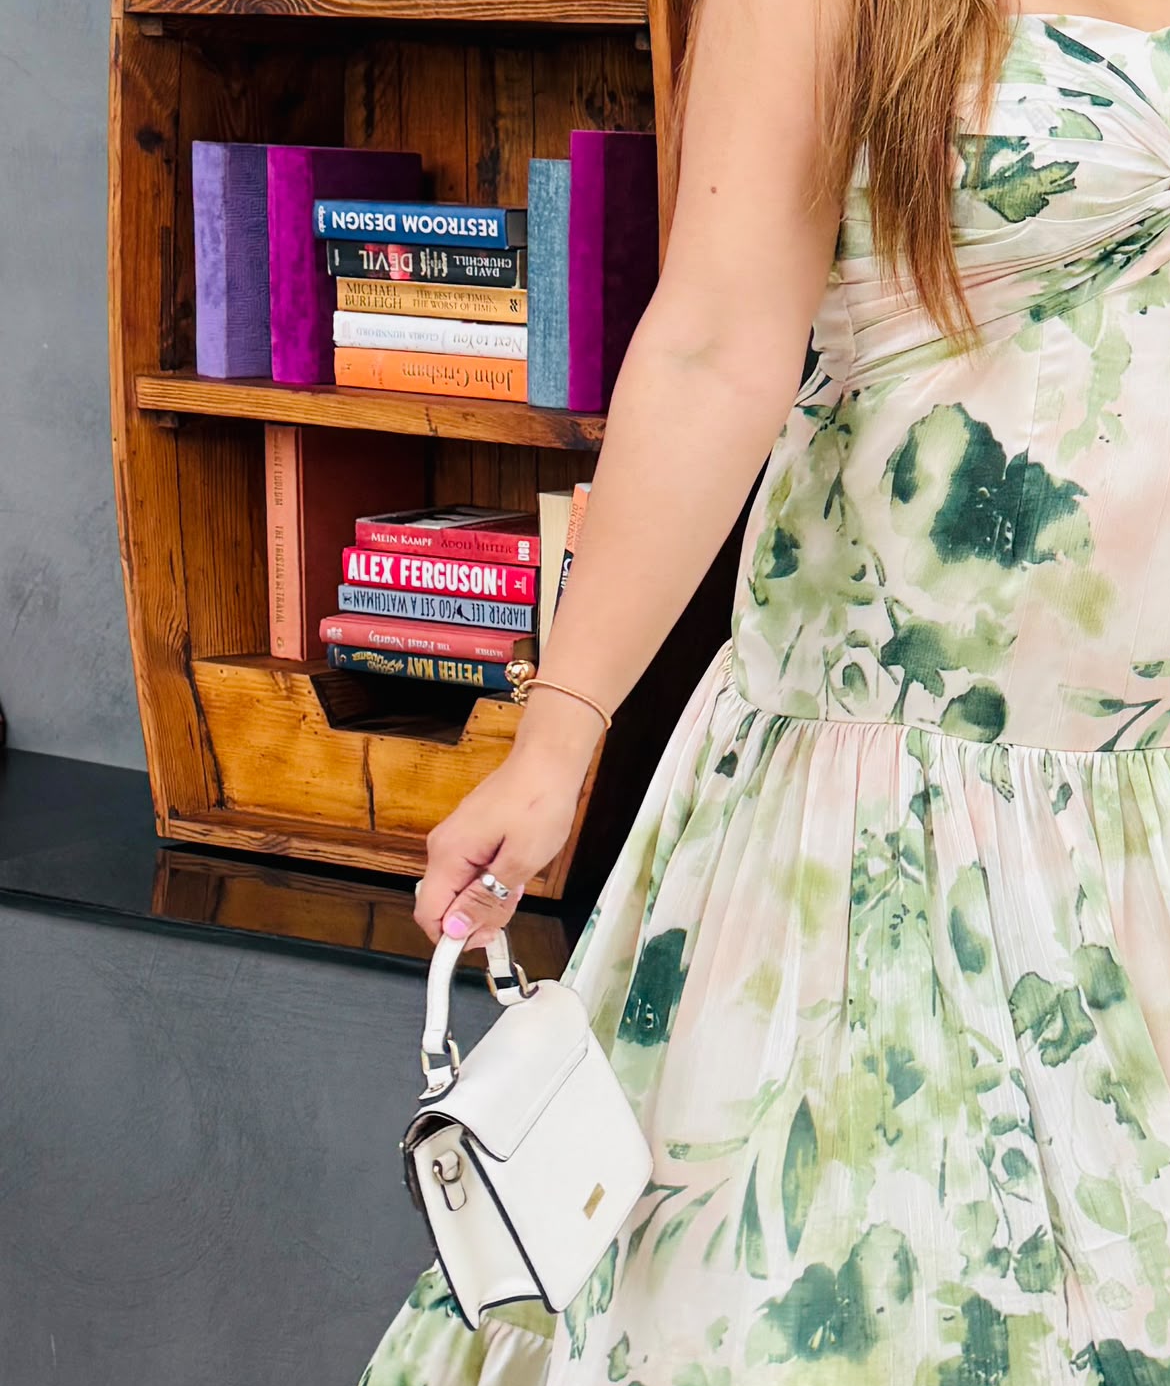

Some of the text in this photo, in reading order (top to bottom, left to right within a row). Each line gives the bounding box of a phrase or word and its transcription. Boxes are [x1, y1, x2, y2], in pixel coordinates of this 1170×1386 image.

[332, 211, 499, 237] RESTROOM DESIGN
[358, 250, 413, 273] DEVIL
[452, 255, 512, 269] CHURCHILL
[466, 267, 500, 277] DAVID
[346, 283, 399, 297] MICHAEL
[416, 289, 434, 299] THE
[434, 291, 452, 301] BEST
[454, 292, 464, 301] OF
[344, 294, 402, 309] BURLEIGH
[412, 299, 430, 308] THE
[430, 301, 458, 310] WORST
[460, 303, 470, 311] OF
[452, 333, 525, 353] Next to You
[402, 363, 470, 387] Grisham
[474, 368, 514, 392] John
[370, 532, 433, 547] MEIN KAMPF
[440, 539, 472, 551] ADOLF
[348, 553, 394, 585] ALEX
[400, 559, 498, 596] FERGUSON
[354, 589, 408, 612] WATCHMAN
[411, 596, 417, 615] A
[420, 597, 436, 617] SET
[471, 601, 486, 623] LEE
[490, 605, 527, 628] HARPER
[368, 630, 404, 649] Nearby
[408, 639, 435, 653] Feast
[406, 656, 435, 680] KAY
[438, 660, 484, 686] PETER
